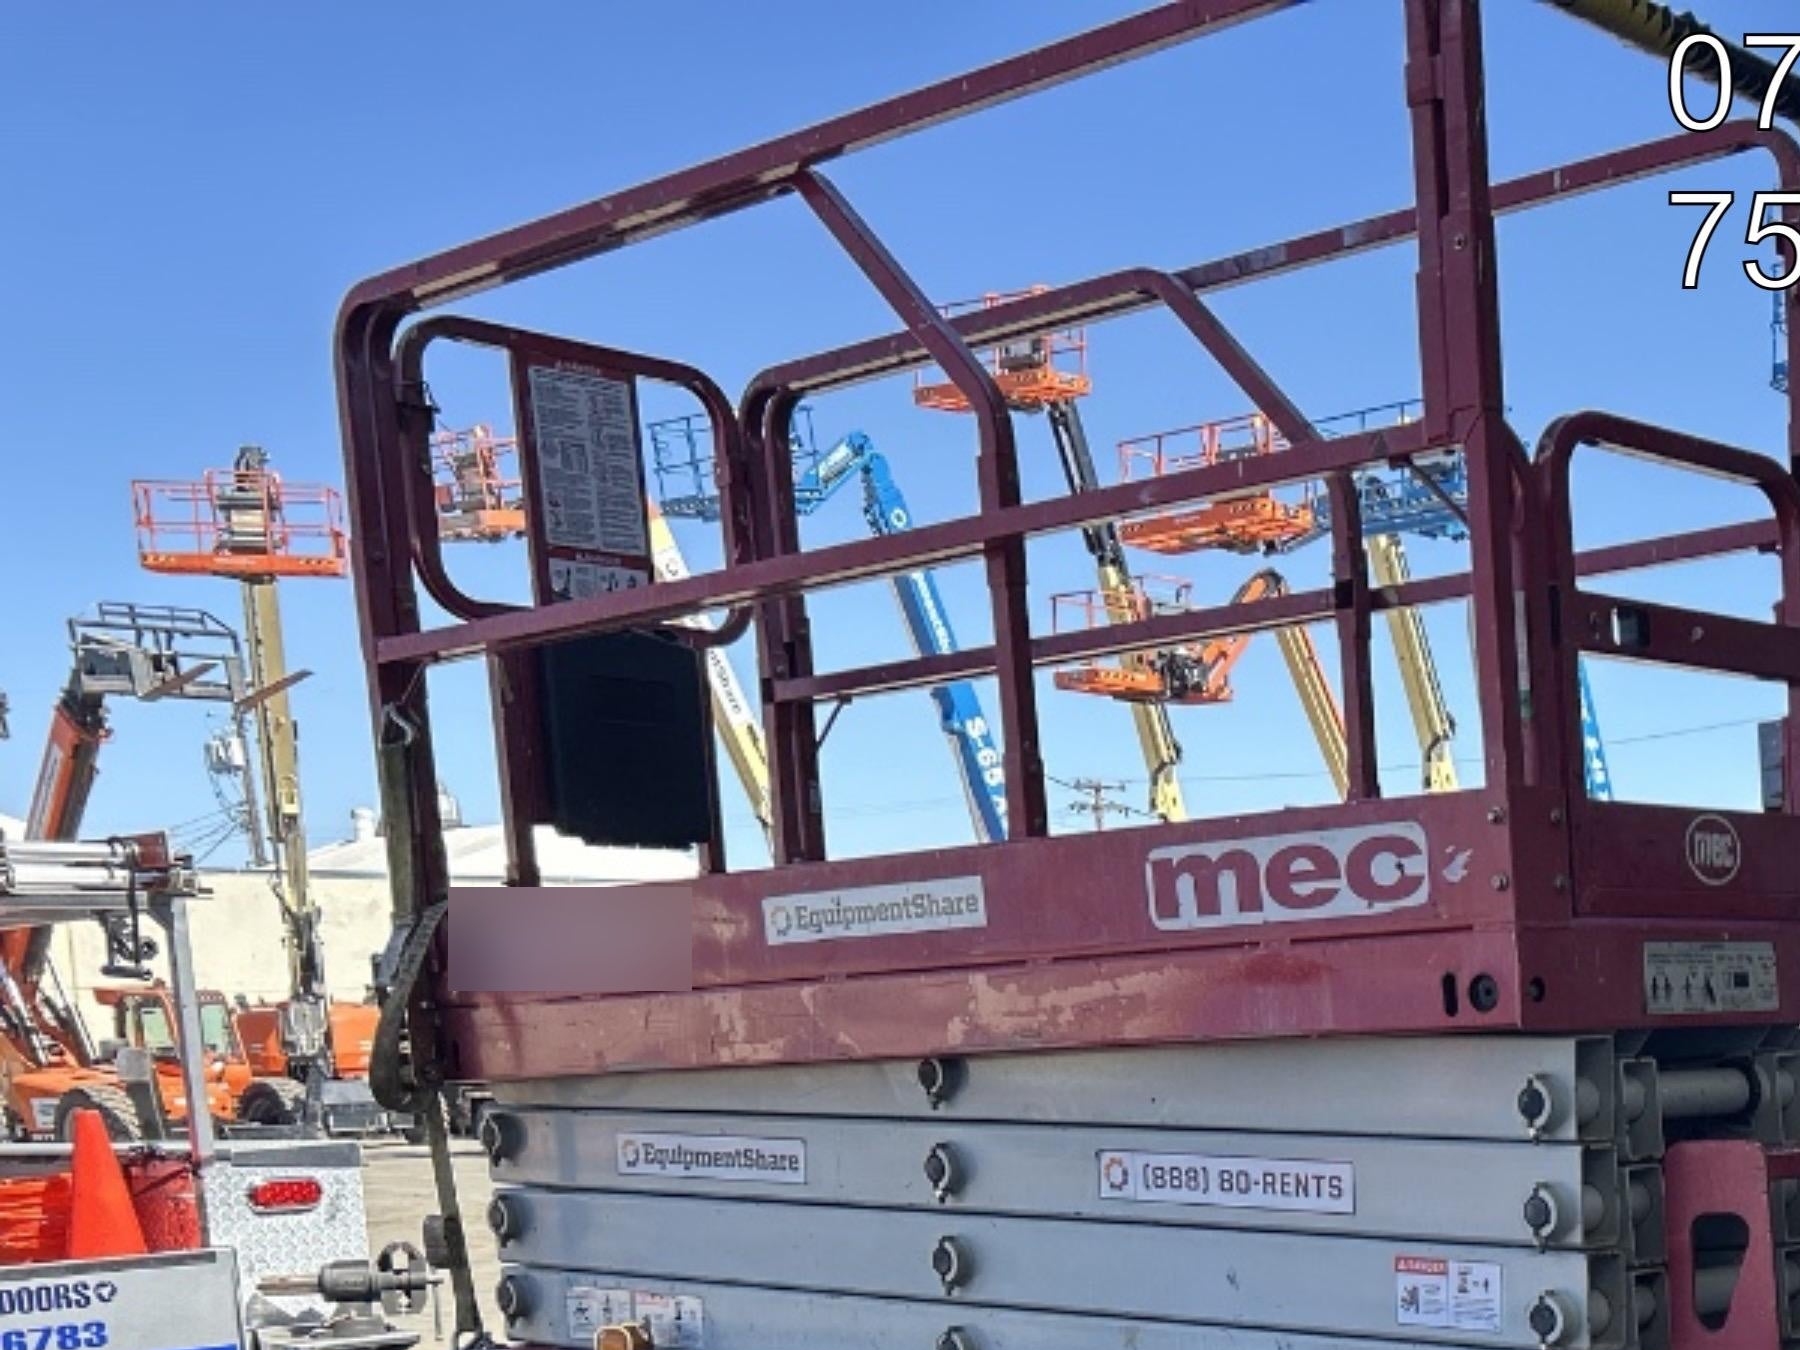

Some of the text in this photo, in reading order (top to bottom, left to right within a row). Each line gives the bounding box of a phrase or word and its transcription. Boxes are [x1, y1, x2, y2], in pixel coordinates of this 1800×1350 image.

[1149, 834, 1426, 919] mec
[794, 893, 979, 932] EquipmentShare
[641, 1142, 800, 1172] EquipmentShare
[1142, 1163, 1343, 1201] (888) 80-RENTS
[0, 1281, 92, 1315] DOORS
